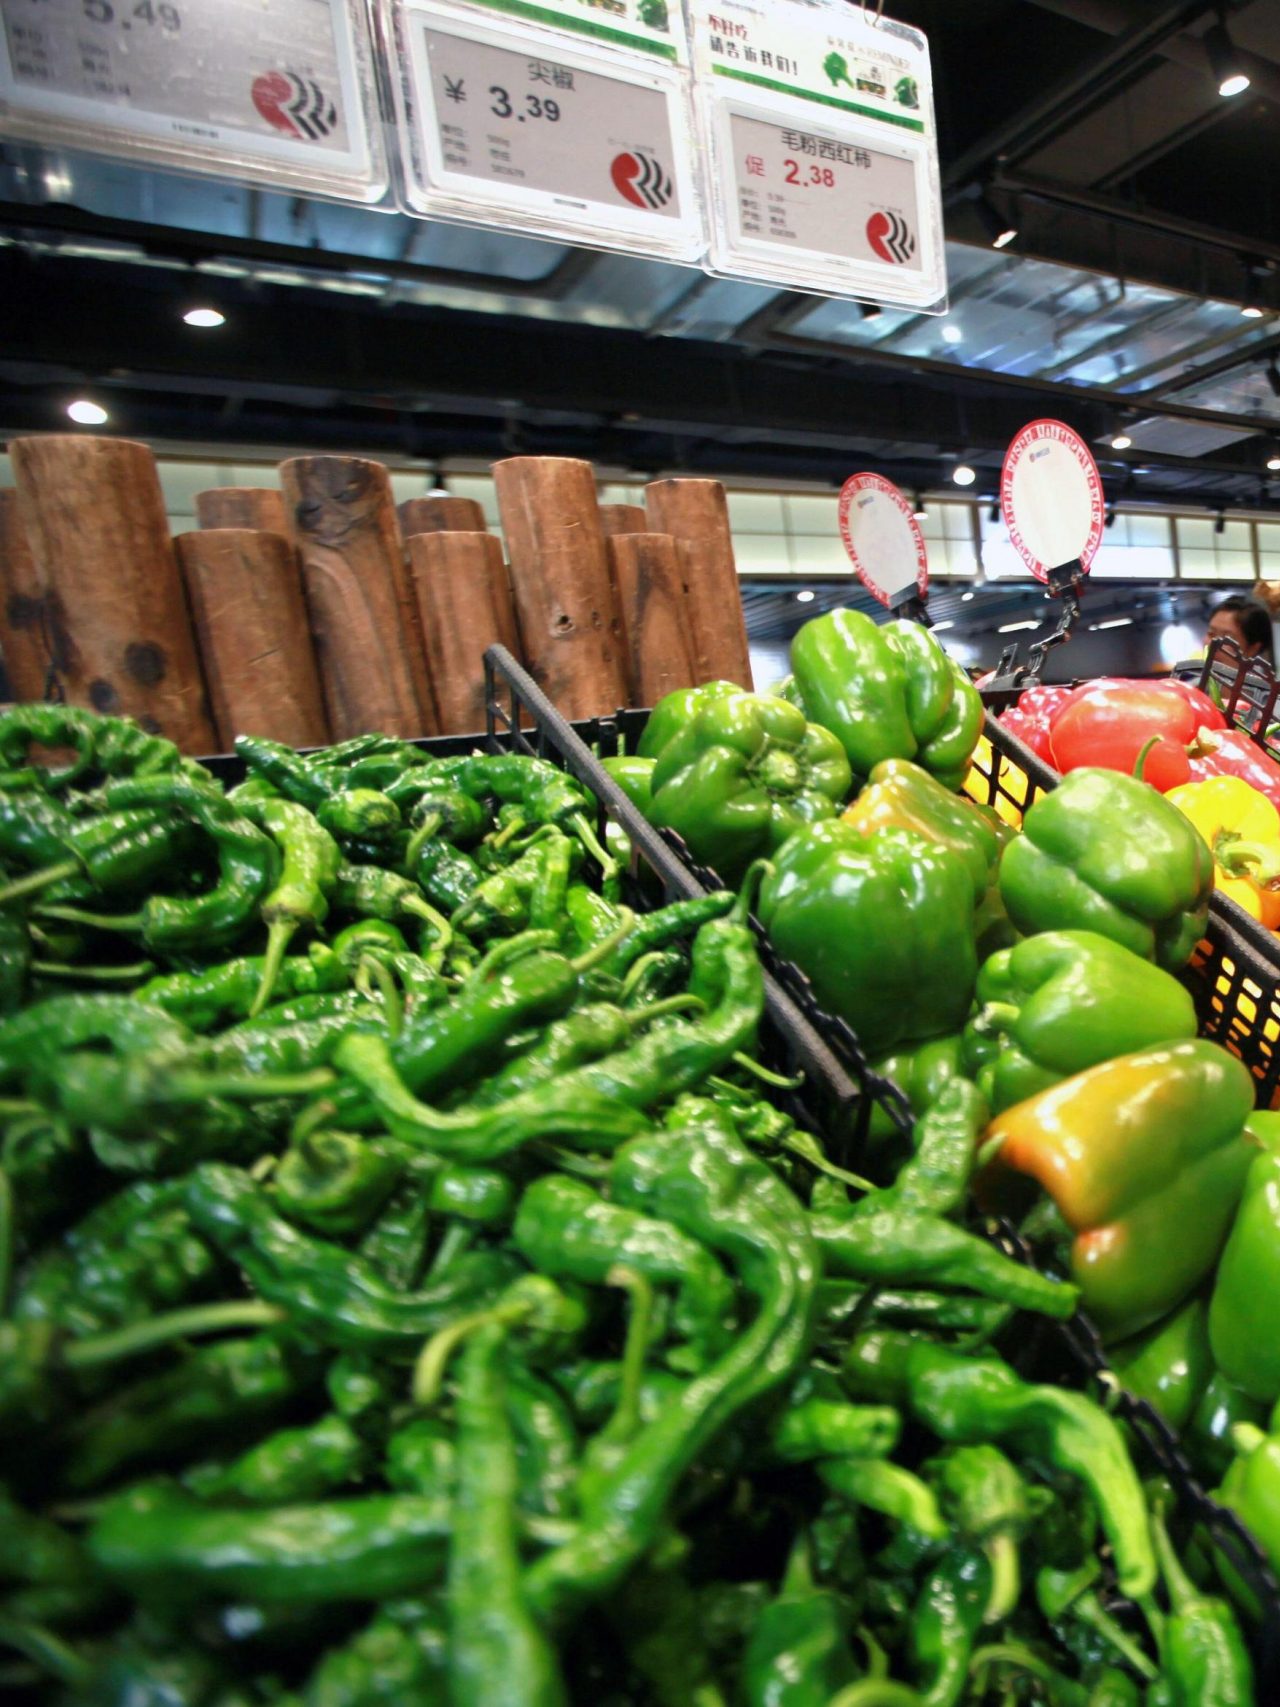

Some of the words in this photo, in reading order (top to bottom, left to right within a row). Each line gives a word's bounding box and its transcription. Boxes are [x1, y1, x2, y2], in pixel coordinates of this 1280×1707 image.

[527, 62, 576, 92] 尖椒
[489, 86, 561, 122] 3.39
[781, 130, 872, 170] 毛粉西红柿
[745, 155, 766, 177] 促
[784, 159, 835, 187] 2.38
